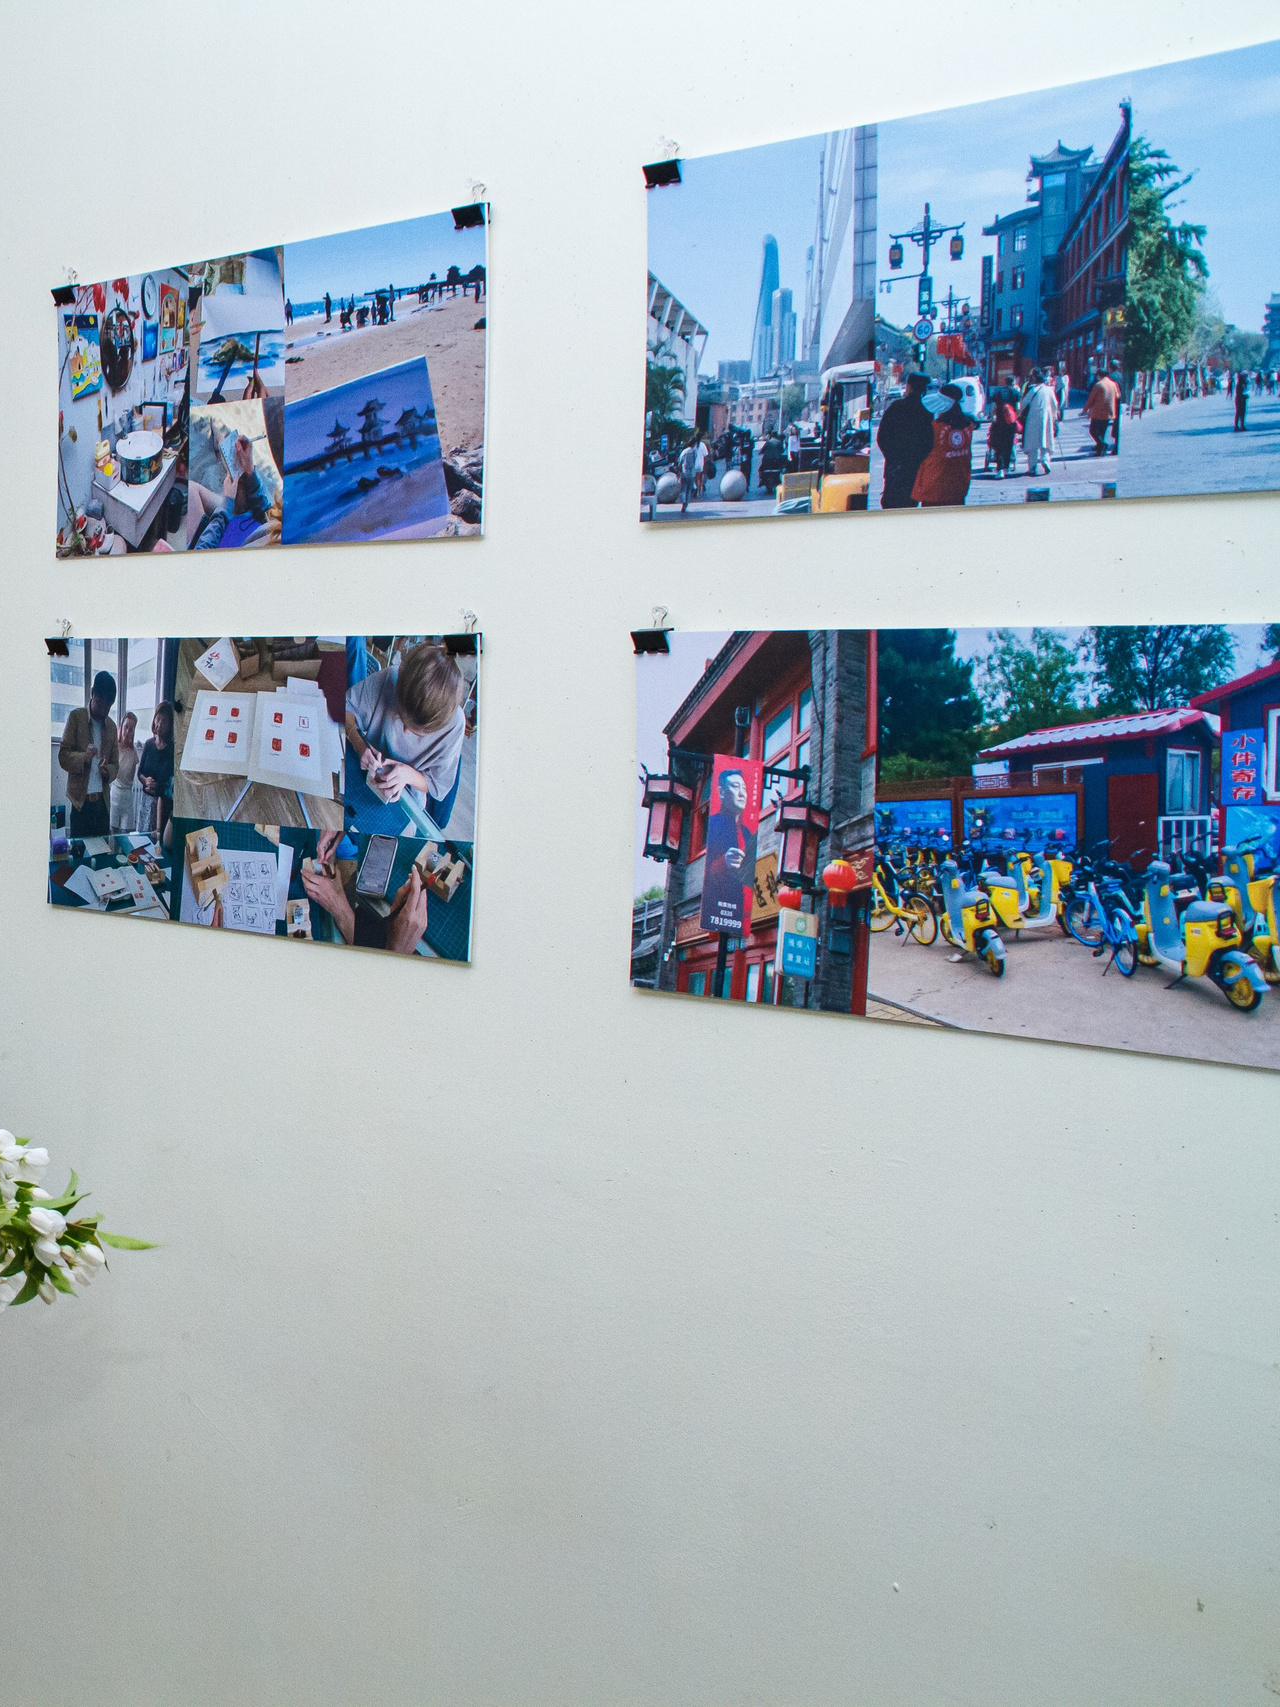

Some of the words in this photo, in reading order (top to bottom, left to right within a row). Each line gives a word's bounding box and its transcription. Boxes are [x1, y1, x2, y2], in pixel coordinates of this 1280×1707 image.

[917, 325, 930, 335] 60
[1231, 733, 1257, 800] 小件寄存
[710, 915, 742, 929] 7819999
